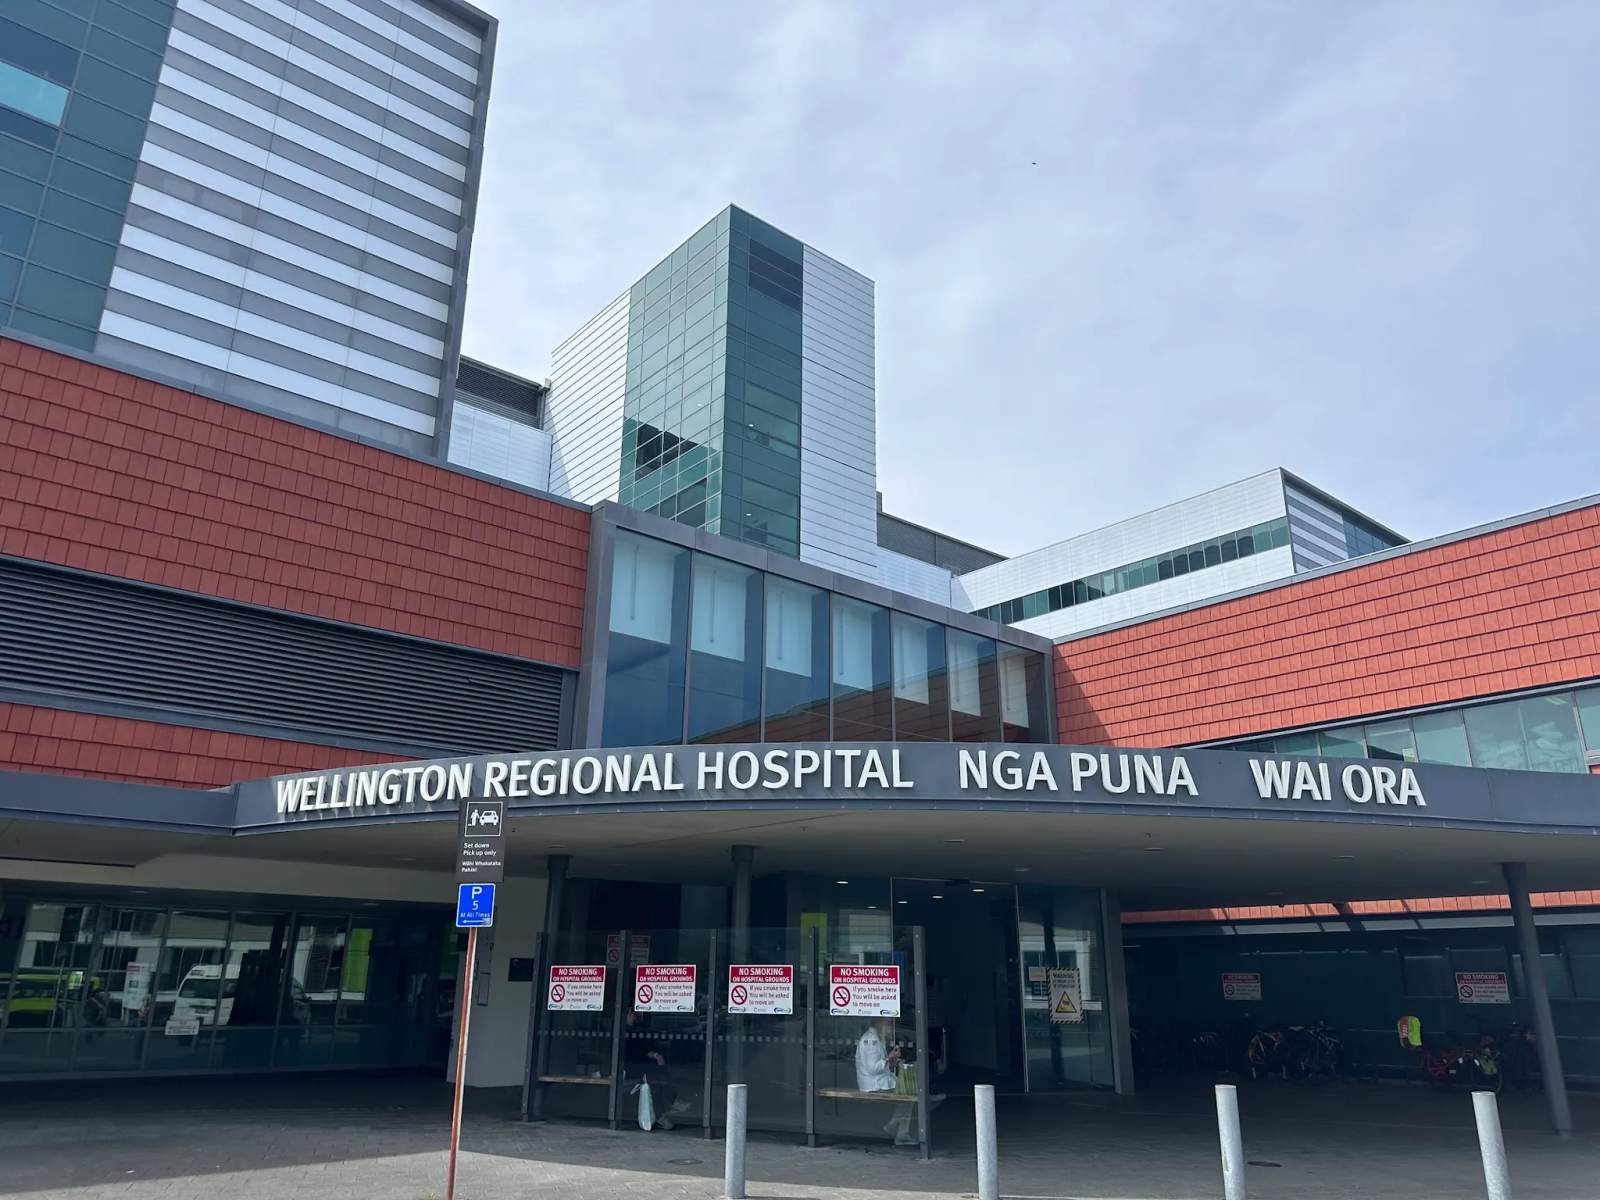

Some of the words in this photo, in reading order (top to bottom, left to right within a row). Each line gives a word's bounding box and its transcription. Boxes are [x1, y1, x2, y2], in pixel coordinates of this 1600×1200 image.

[277, 763, 473, 813] WELLINGTON
[484, 753, 684, 797] REGIONAL
[698, 749, 914, 790] HOSPITAL
[959, 750, 1058, 790] NGA
[1070, 753, 1199, 795] PUNA
[1249, 759, 1331, 800] WAI
[1342, 765, 1426, 805] ORA
[484, 849, 497, 857] only
[471, 886, 482, 899] P
[472, 900, 479, 911] 5
[558, 967, 568, 976] NO
[568, 967, 598, 976] SMOKING
[645, 967, 655, 976] NO
[656, 967, 687, 976] SMOKING
[739, 967, 749, 976] NO
[750, 967, 784, 976] SMOKING
[840, 968, 851, 976] NO
[853, 968, 889, 976] SMOKING
